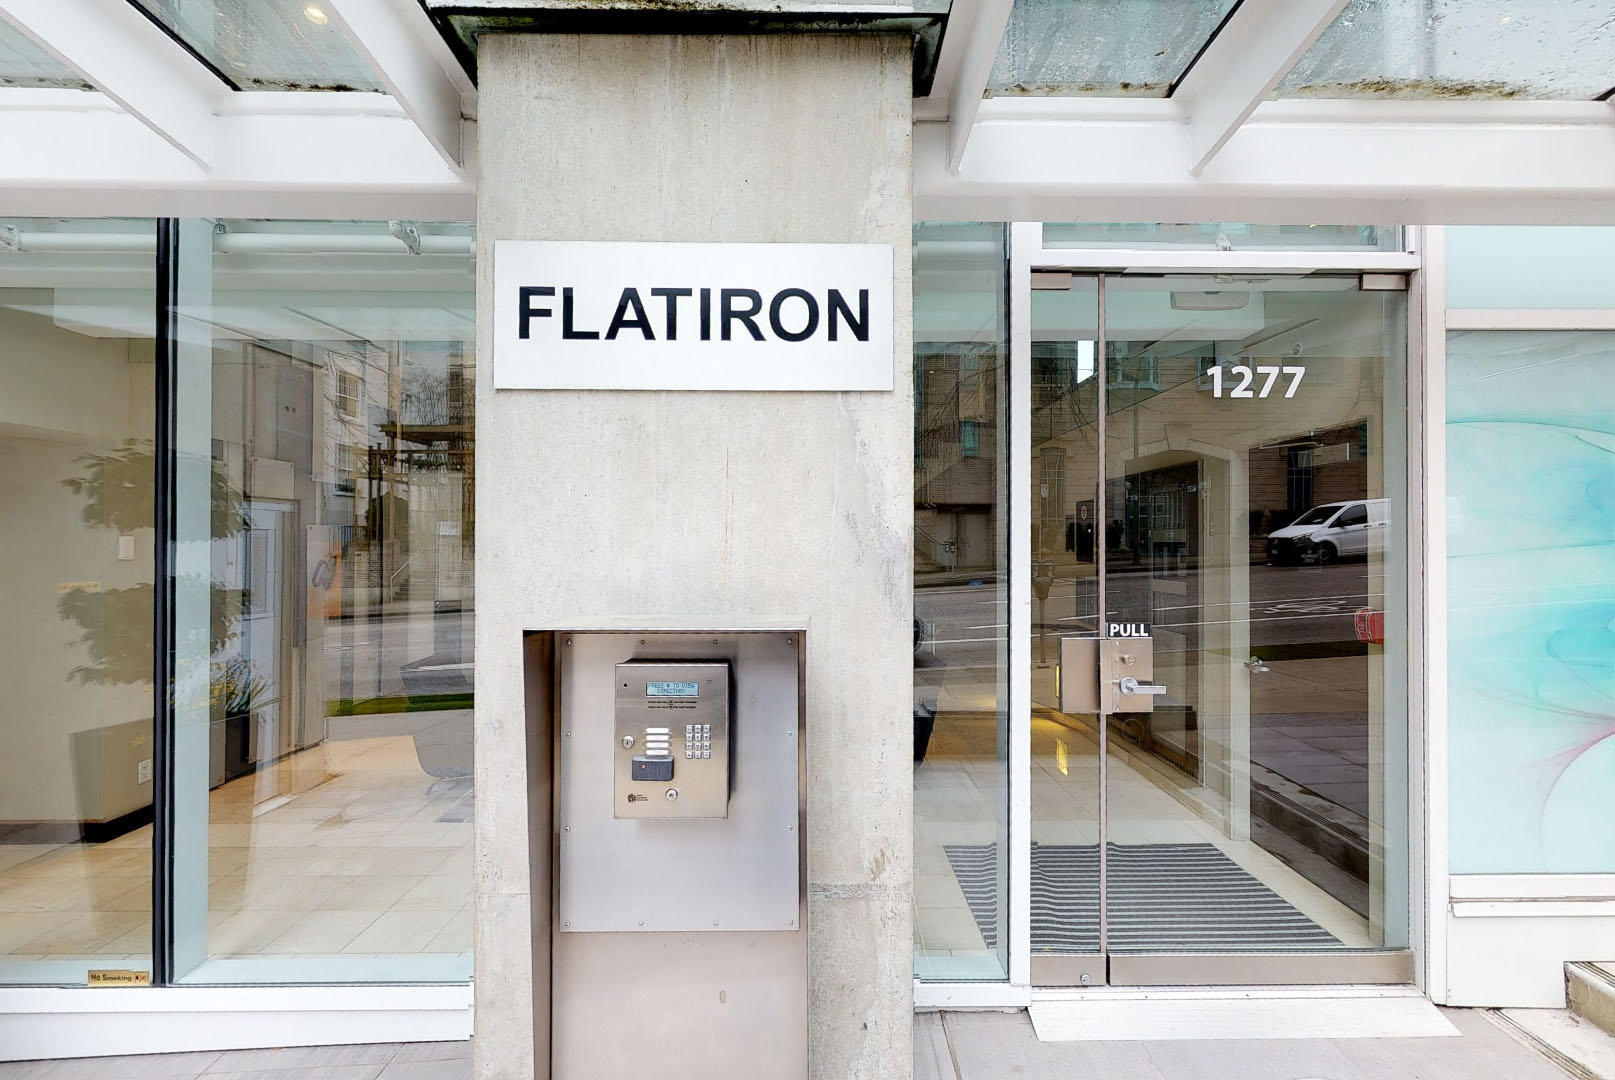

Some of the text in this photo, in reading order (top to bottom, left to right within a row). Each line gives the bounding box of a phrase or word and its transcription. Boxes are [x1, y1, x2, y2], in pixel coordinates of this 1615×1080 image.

[519, 286, 869, 342] FLATIRON
[1206, 365, 1306, 398] 1277
[1109, 623, 1149, 637] PULL
